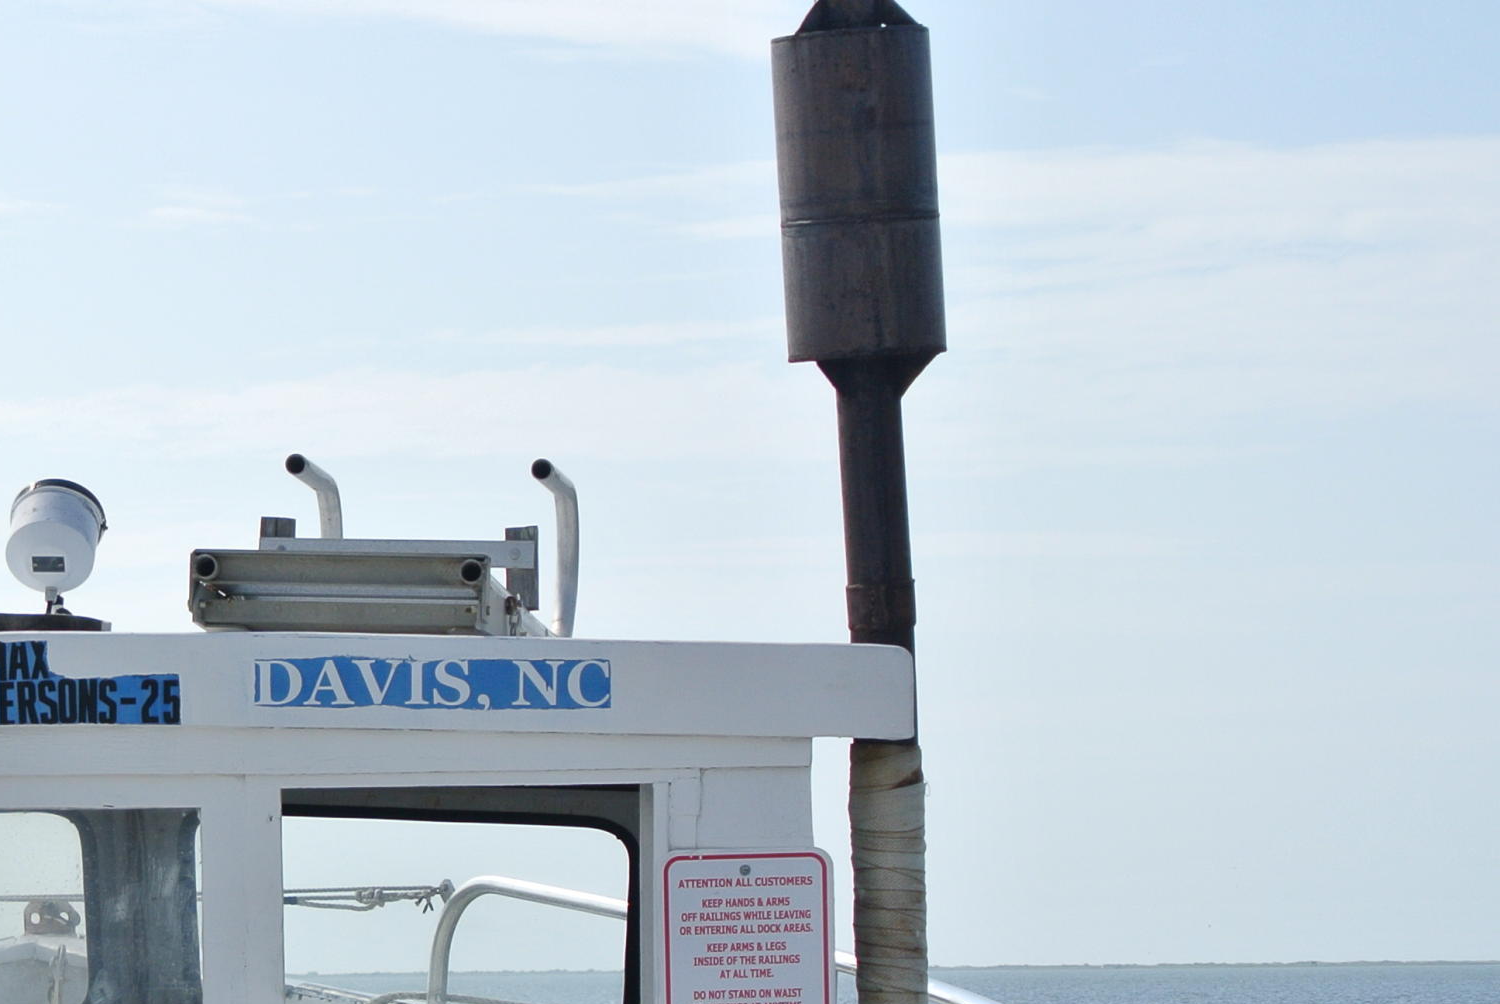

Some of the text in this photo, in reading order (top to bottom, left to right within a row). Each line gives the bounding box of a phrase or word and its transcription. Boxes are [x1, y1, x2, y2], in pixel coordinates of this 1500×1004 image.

[254, 657, 611, 711] DAVIS, NC
[678, 876, 813, 888] ATTENTION ALL CUSTOMERS
[701, 897, 790, 908] KEEP HANDS & ARMS
[681, 910, 811, 922] OFF RAILINGS WHILE LEAVING
[679, 923, 813, 935] OR ENTERING ALL DOCK AREAS.
[707, 941, 787, 953] KEEP ARMS & LEGS
[693, 954, 801, 966] INSIDE OF THE RAILINGS
[719, 968, 774, 979] AT ALL TIME.
[693, 988, 802, 1000] DO NOT STAND ON WAIST
